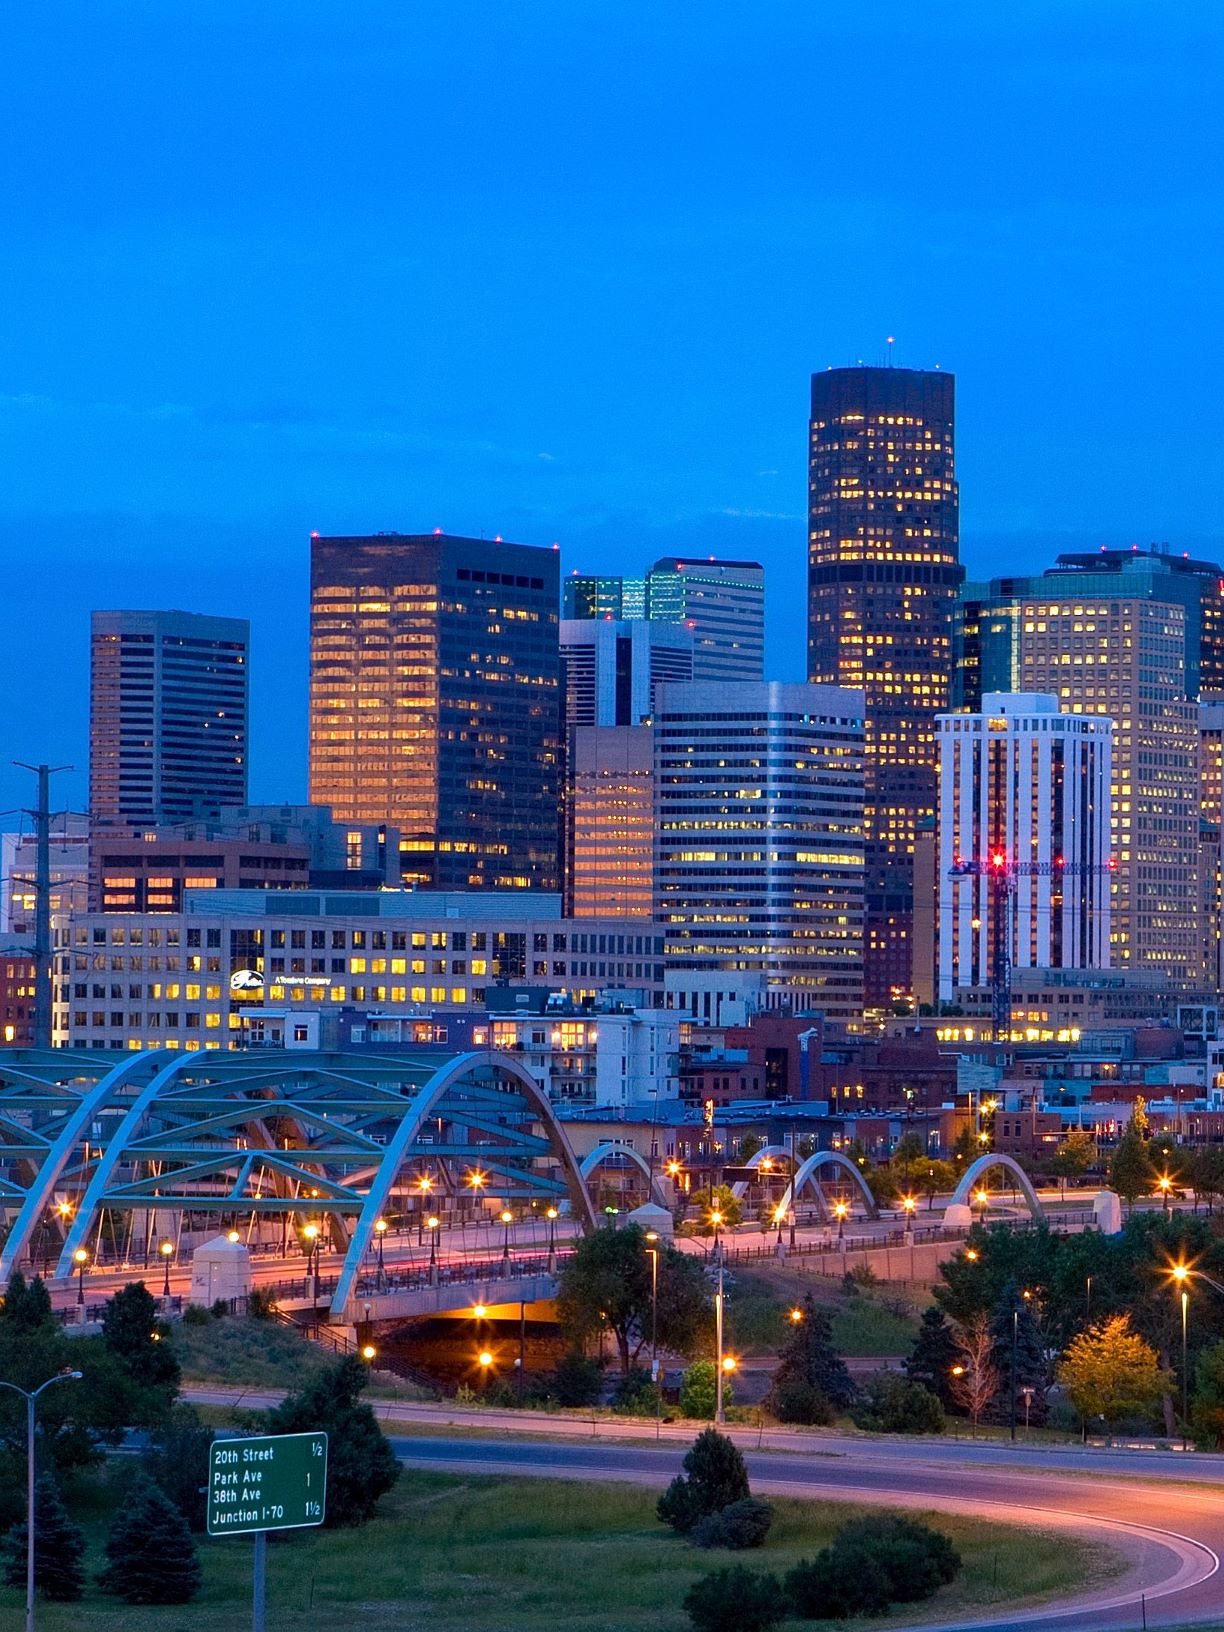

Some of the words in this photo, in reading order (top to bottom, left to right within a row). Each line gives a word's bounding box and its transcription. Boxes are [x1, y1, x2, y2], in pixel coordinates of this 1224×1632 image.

[215, 1450, 238, 1464] 20th
[243, 1447, 274, 1462] Street
[214, 1472, 238, 1485] Park
[243, 1470, 262, 1483] Ave
[306, 1473, 311, 1487] 1
[213, 1490, 237, 1503] 38th
[242, 1488, 261, 1501] Ave
[213, 1509, 258, 1525] Junction
[262, 1506, 284, 1520] I-70
